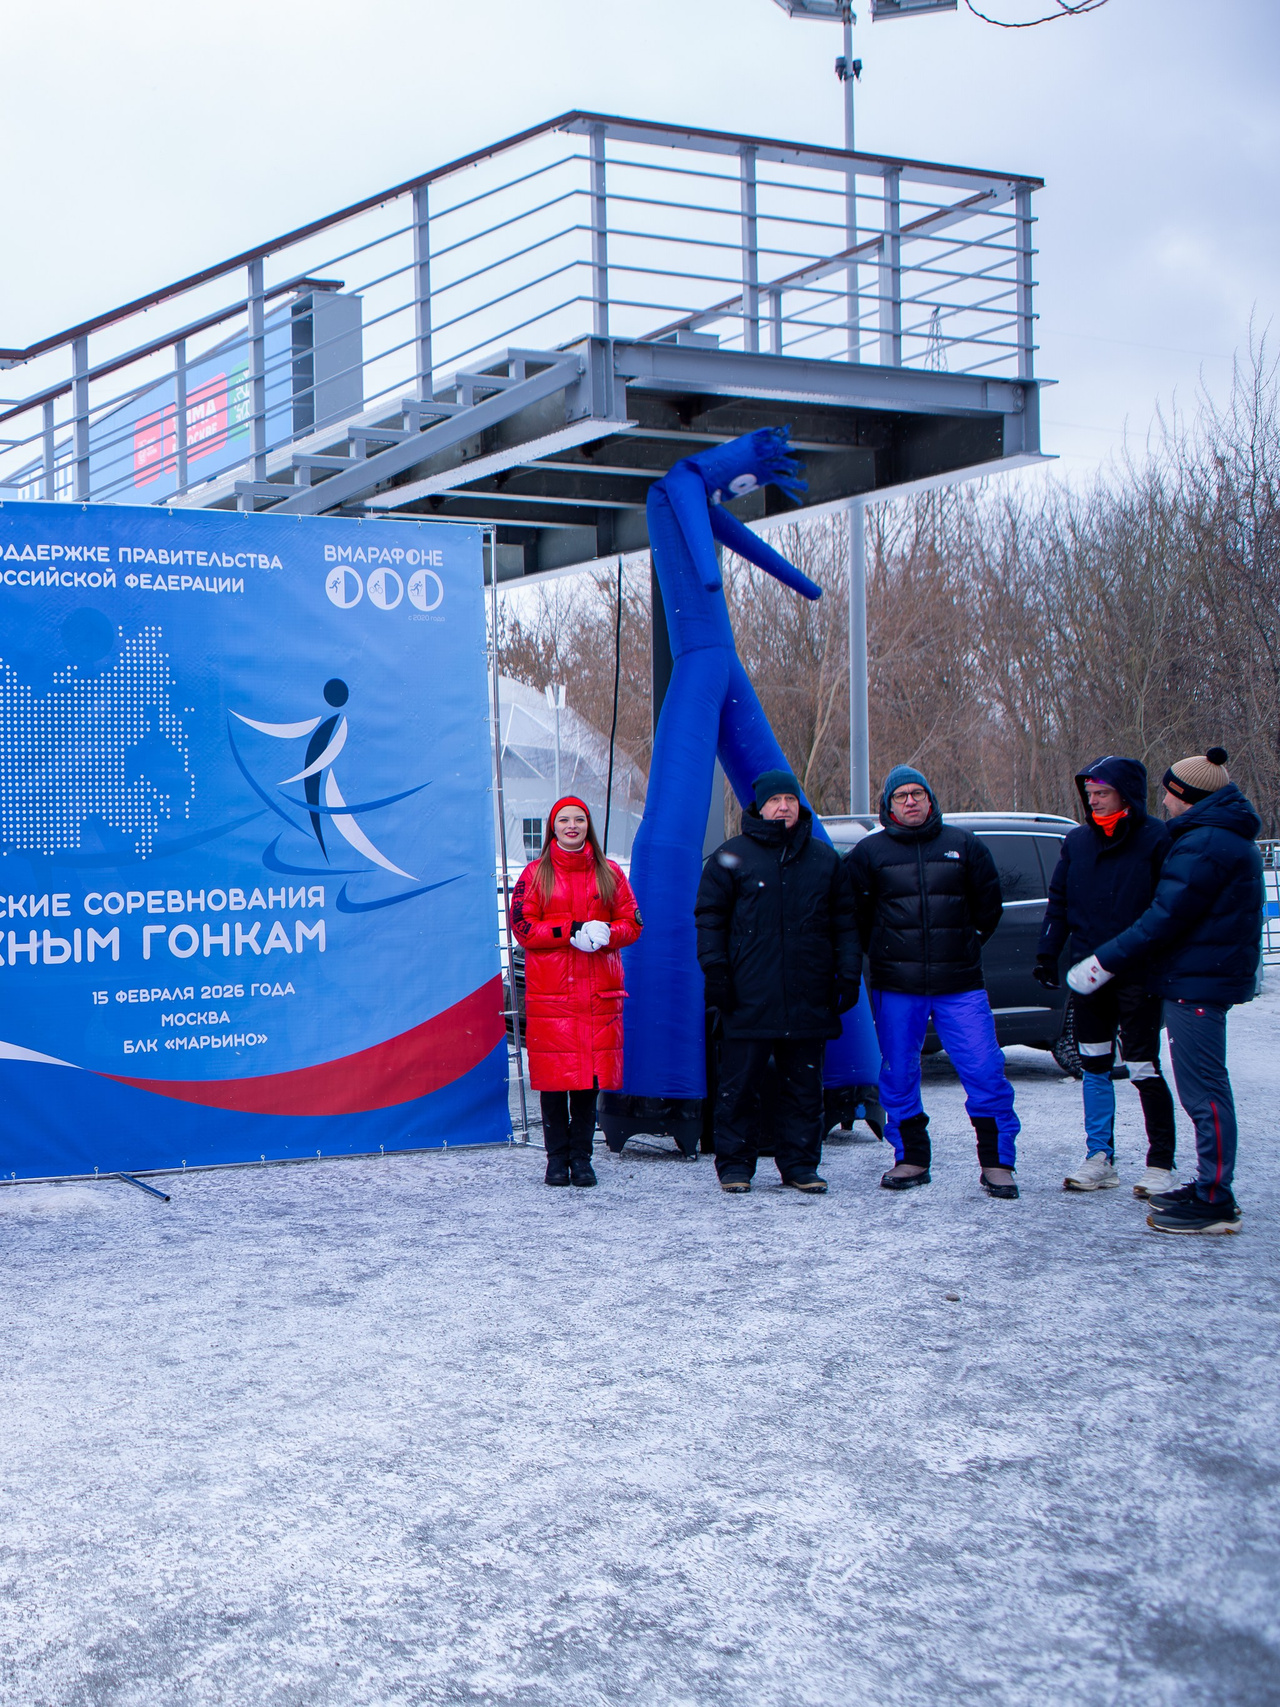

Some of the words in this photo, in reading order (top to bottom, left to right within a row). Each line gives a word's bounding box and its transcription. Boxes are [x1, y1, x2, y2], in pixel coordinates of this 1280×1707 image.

[118, 547, 283, 570] ПРАВИТЕЛЬСТВА
[324, 544, 444, 567] ВМАРАФОНЕ
[124, 573, 245, 594] ФЕДЕРАЦИИ
[413, 614, 430, 622] 2020
[430, 615, 446, 623] года
[83, 885, 325, 916] СОРЕВНОВАНИЯ
[142, 919, 326, 960] ГОНКАМ
[92, 991, 109, 1005] 15
[115, 987, 195, 1004] ФЕВРАЛЯ
[201, 984, 245, 999] 2026
[250, 982, 296, 997] ГОДА
[161, 1010, 231, 1027] МОСКВА
[123, 1039, 159, 1054] БЛК
[164, 1033, 269, 1051] «МАРЬИНО»
